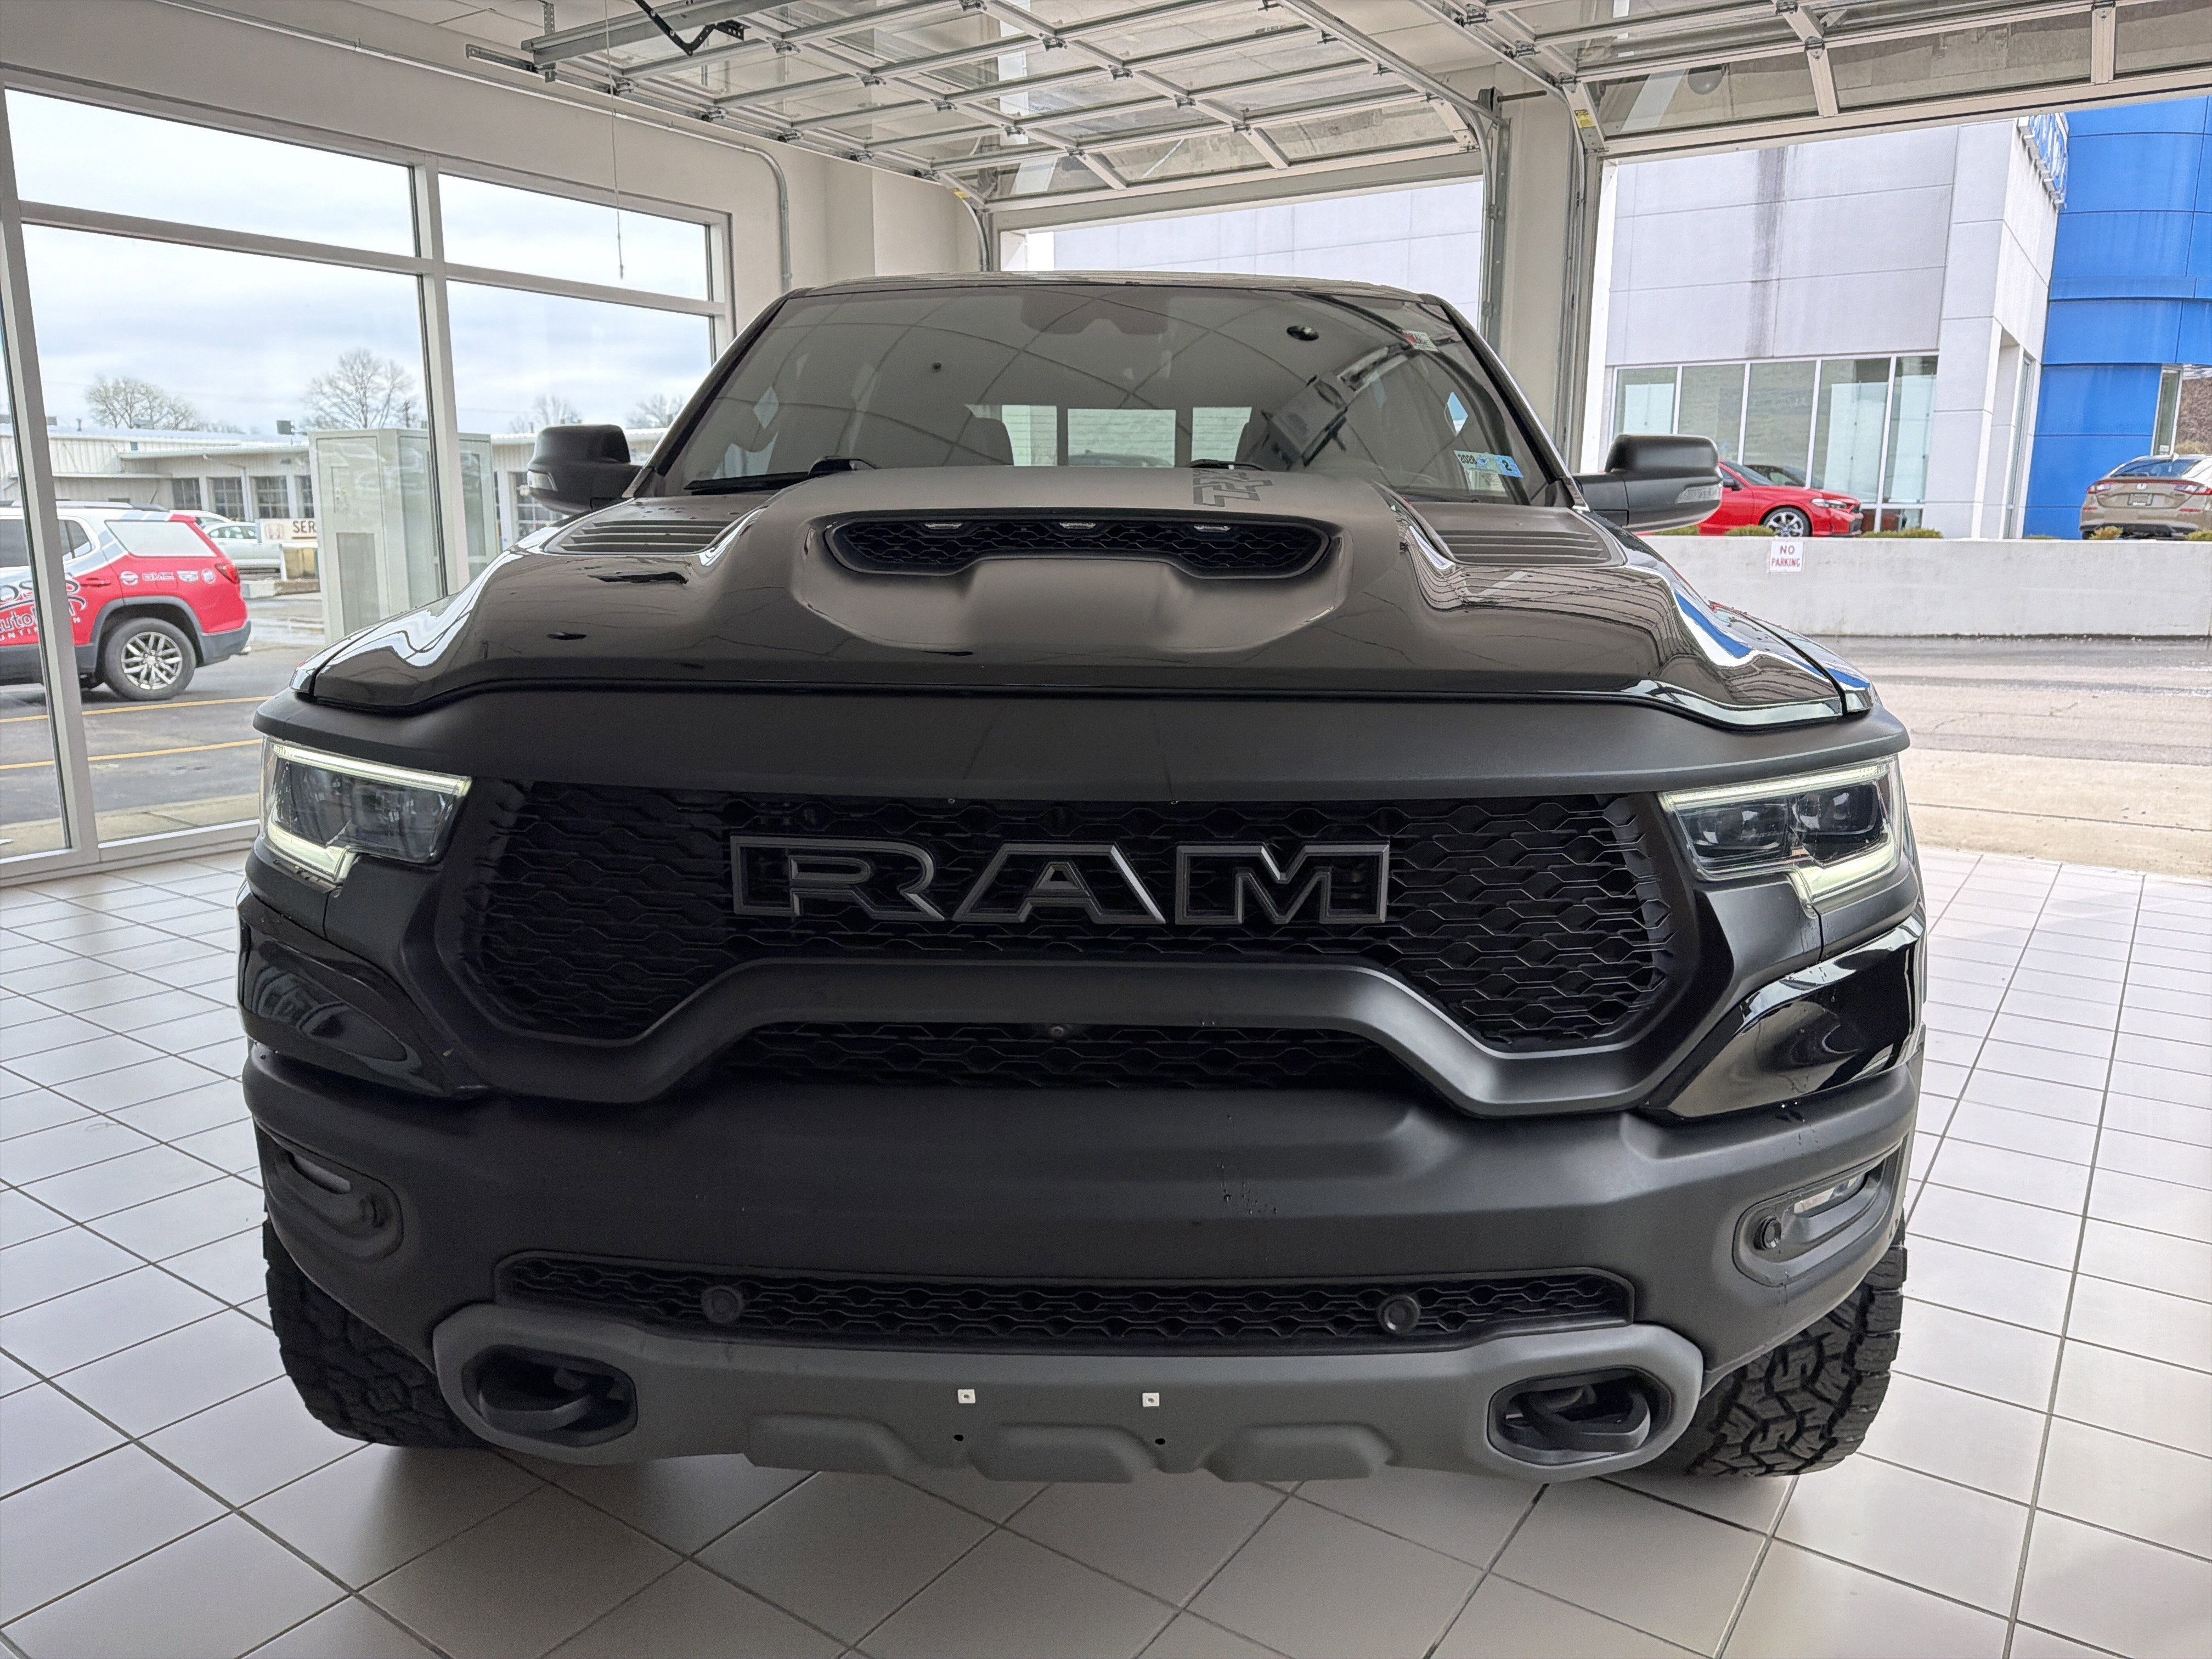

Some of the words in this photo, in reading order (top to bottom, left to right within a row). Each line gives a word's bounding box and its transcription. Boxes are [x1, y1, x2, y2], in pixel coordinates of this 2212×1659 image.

[1502, 459, 1513, 471] 2
[292, 521, 317, 533] SER
[1780, 545, 1795, 555] NO
[1771, 557, 1801, 567] PARKING
[731, 834, 1390, 925] RAM
